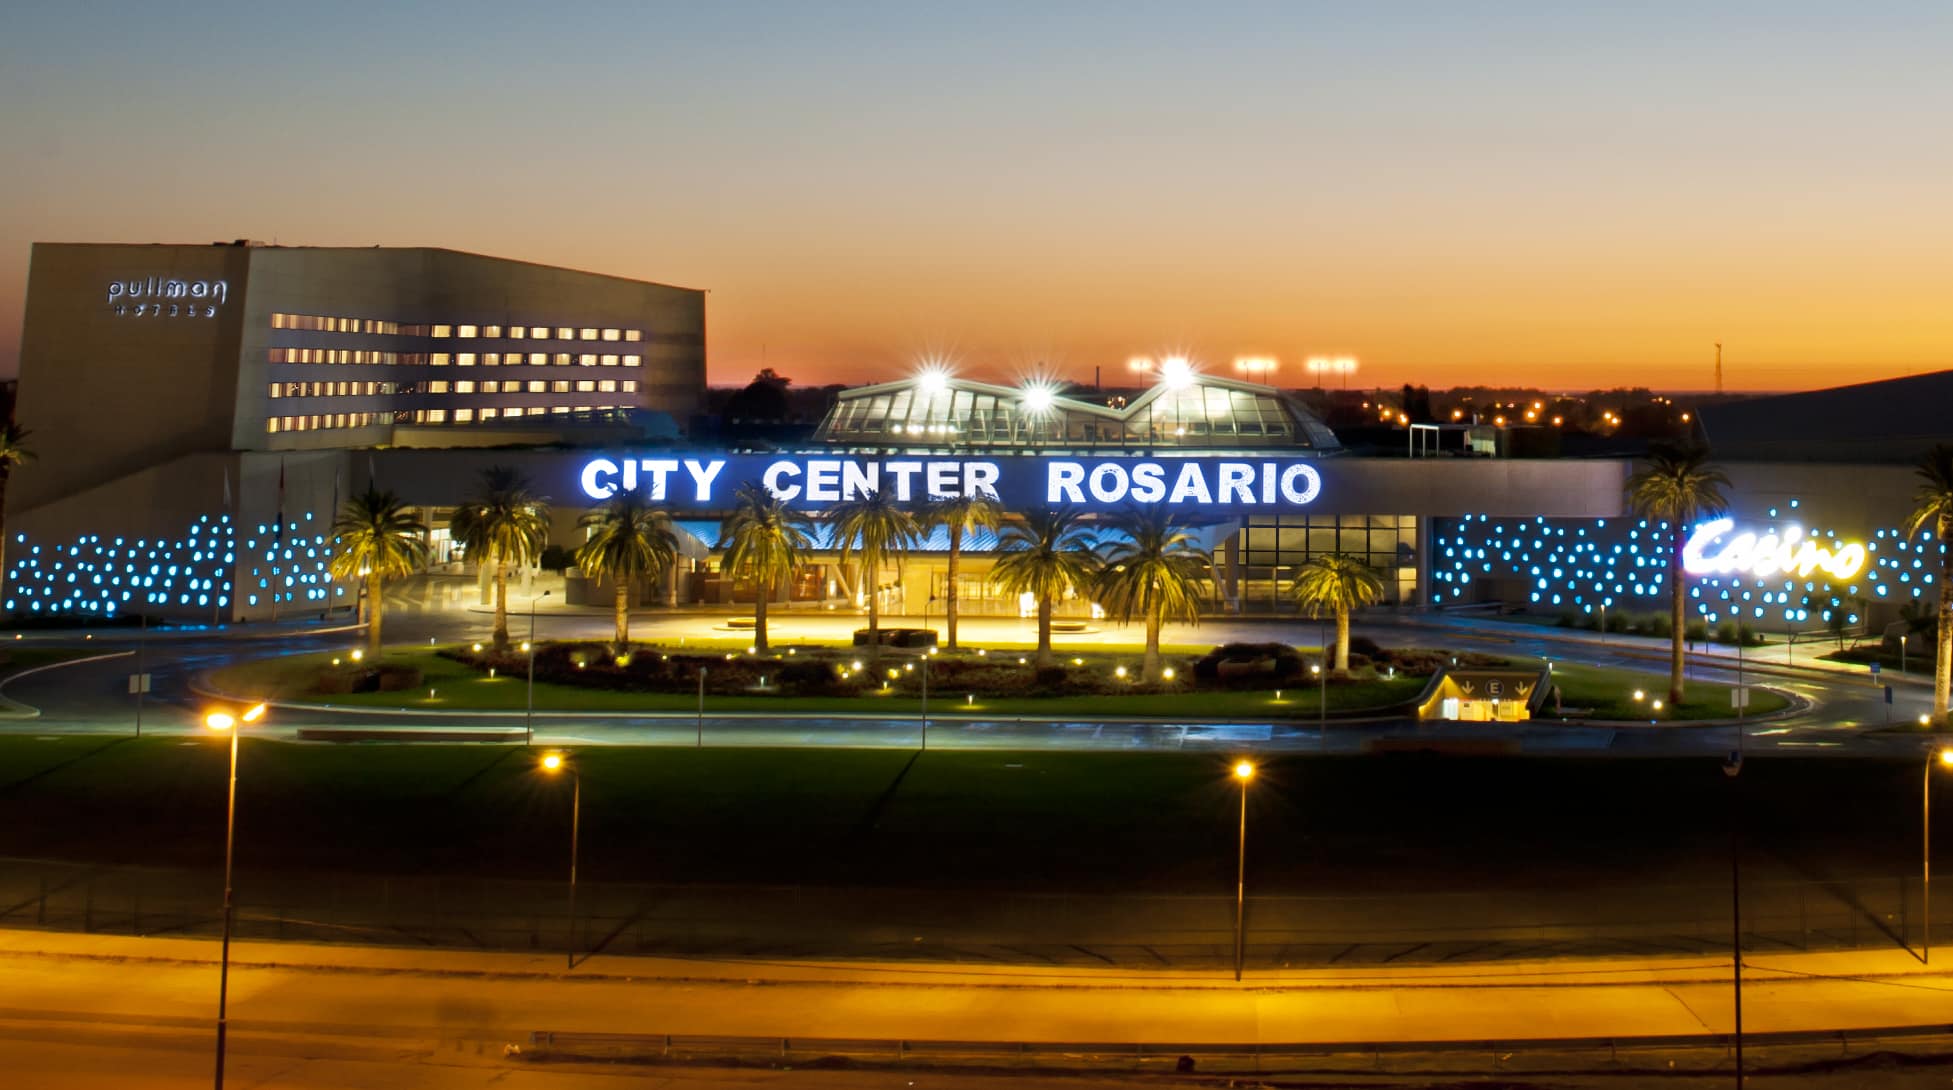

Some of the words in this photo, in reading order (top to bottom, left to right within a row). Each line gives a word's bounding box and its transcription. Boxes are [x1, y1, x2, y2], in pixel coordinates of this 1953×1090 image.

[107, 276, 228, 304] pullman
[115, 304, 216, 318] HOTELS
[581, 459, 727, 501] CITY
[762, 460, 1001, 501] CENTER
[1047, 462, 1322, 504] ROSARIO
[1682, 517, 1866, 579] Casino
[1489, 682, 1500, 694] E
